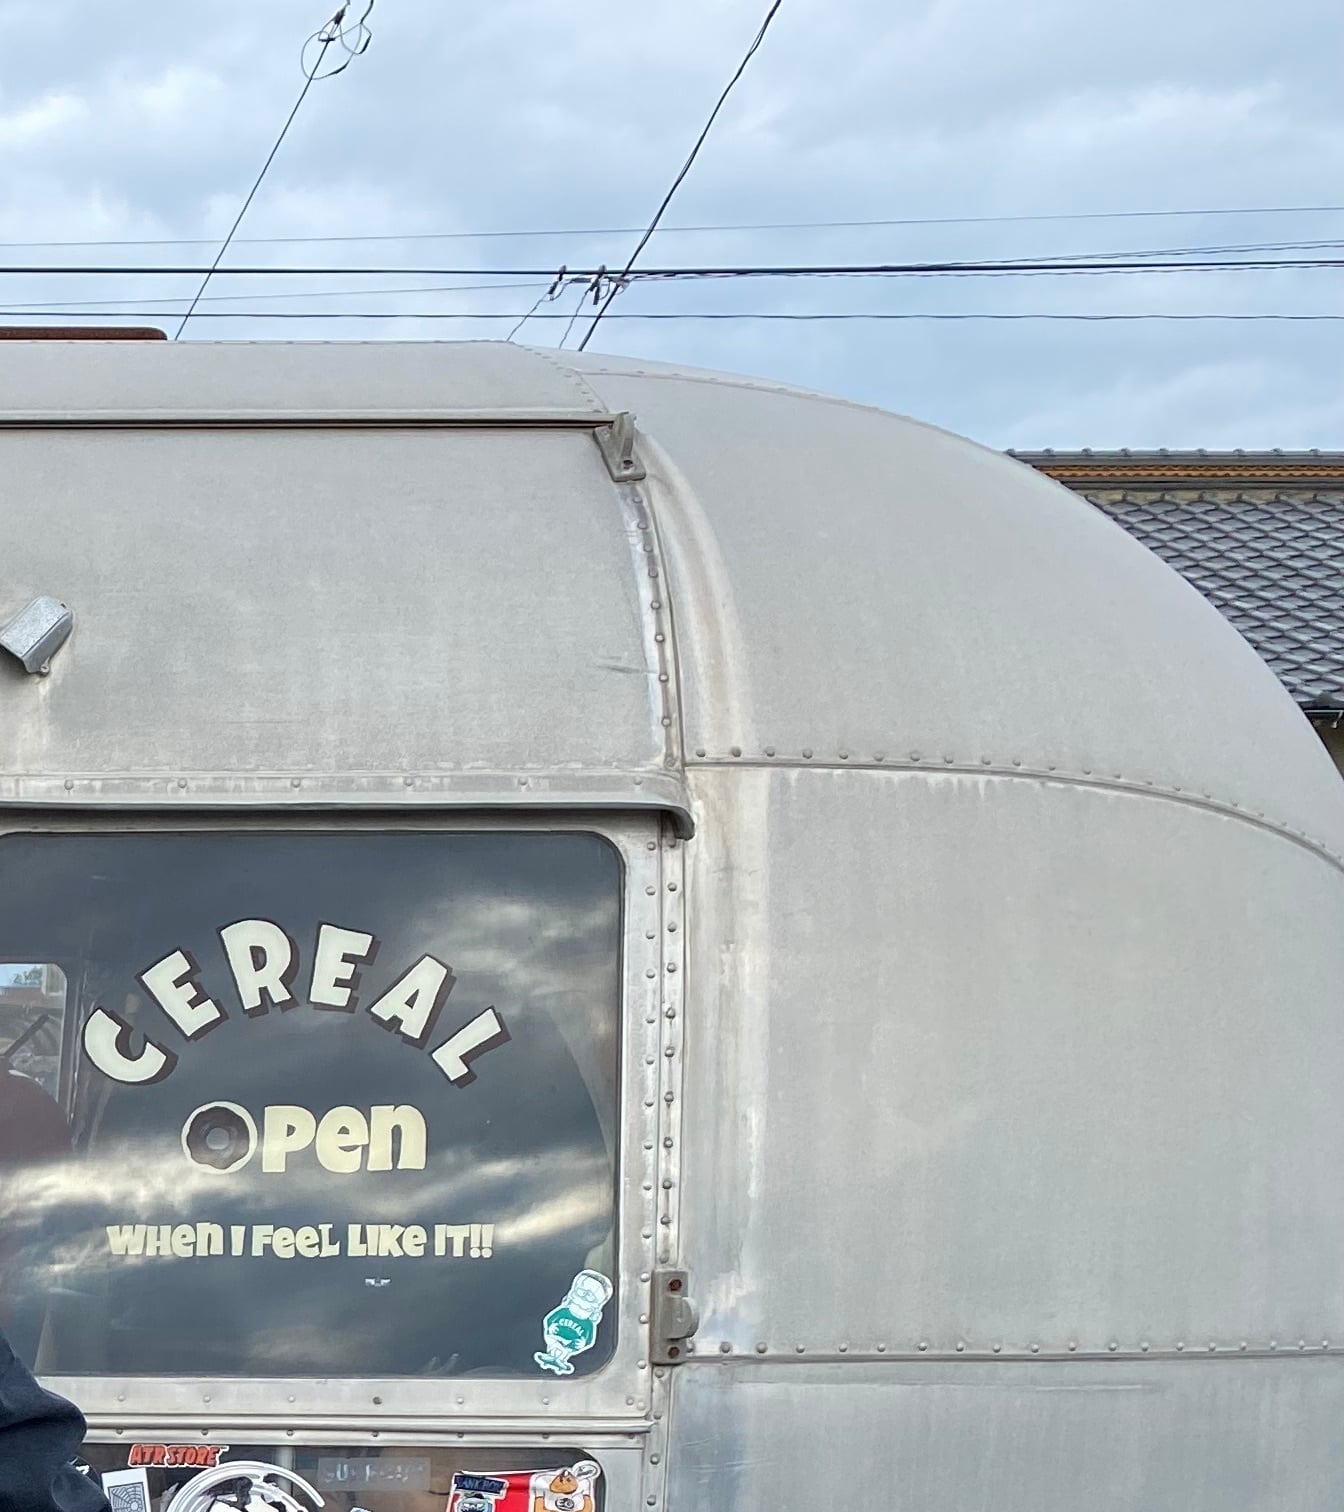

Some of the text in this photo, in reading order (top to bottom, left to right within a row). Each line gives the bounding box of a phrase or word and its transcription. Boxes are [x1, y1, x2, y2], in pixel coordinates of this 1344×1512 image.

[81, 918, 511, 1089] CEREAL
[230, 1224, 245, 1256] I
[434, 1222, 495, 1258] IT!!
[558, 1318, 584, 1336] CEREAL
[130, 1444, 220, 1467] ATR STORE
